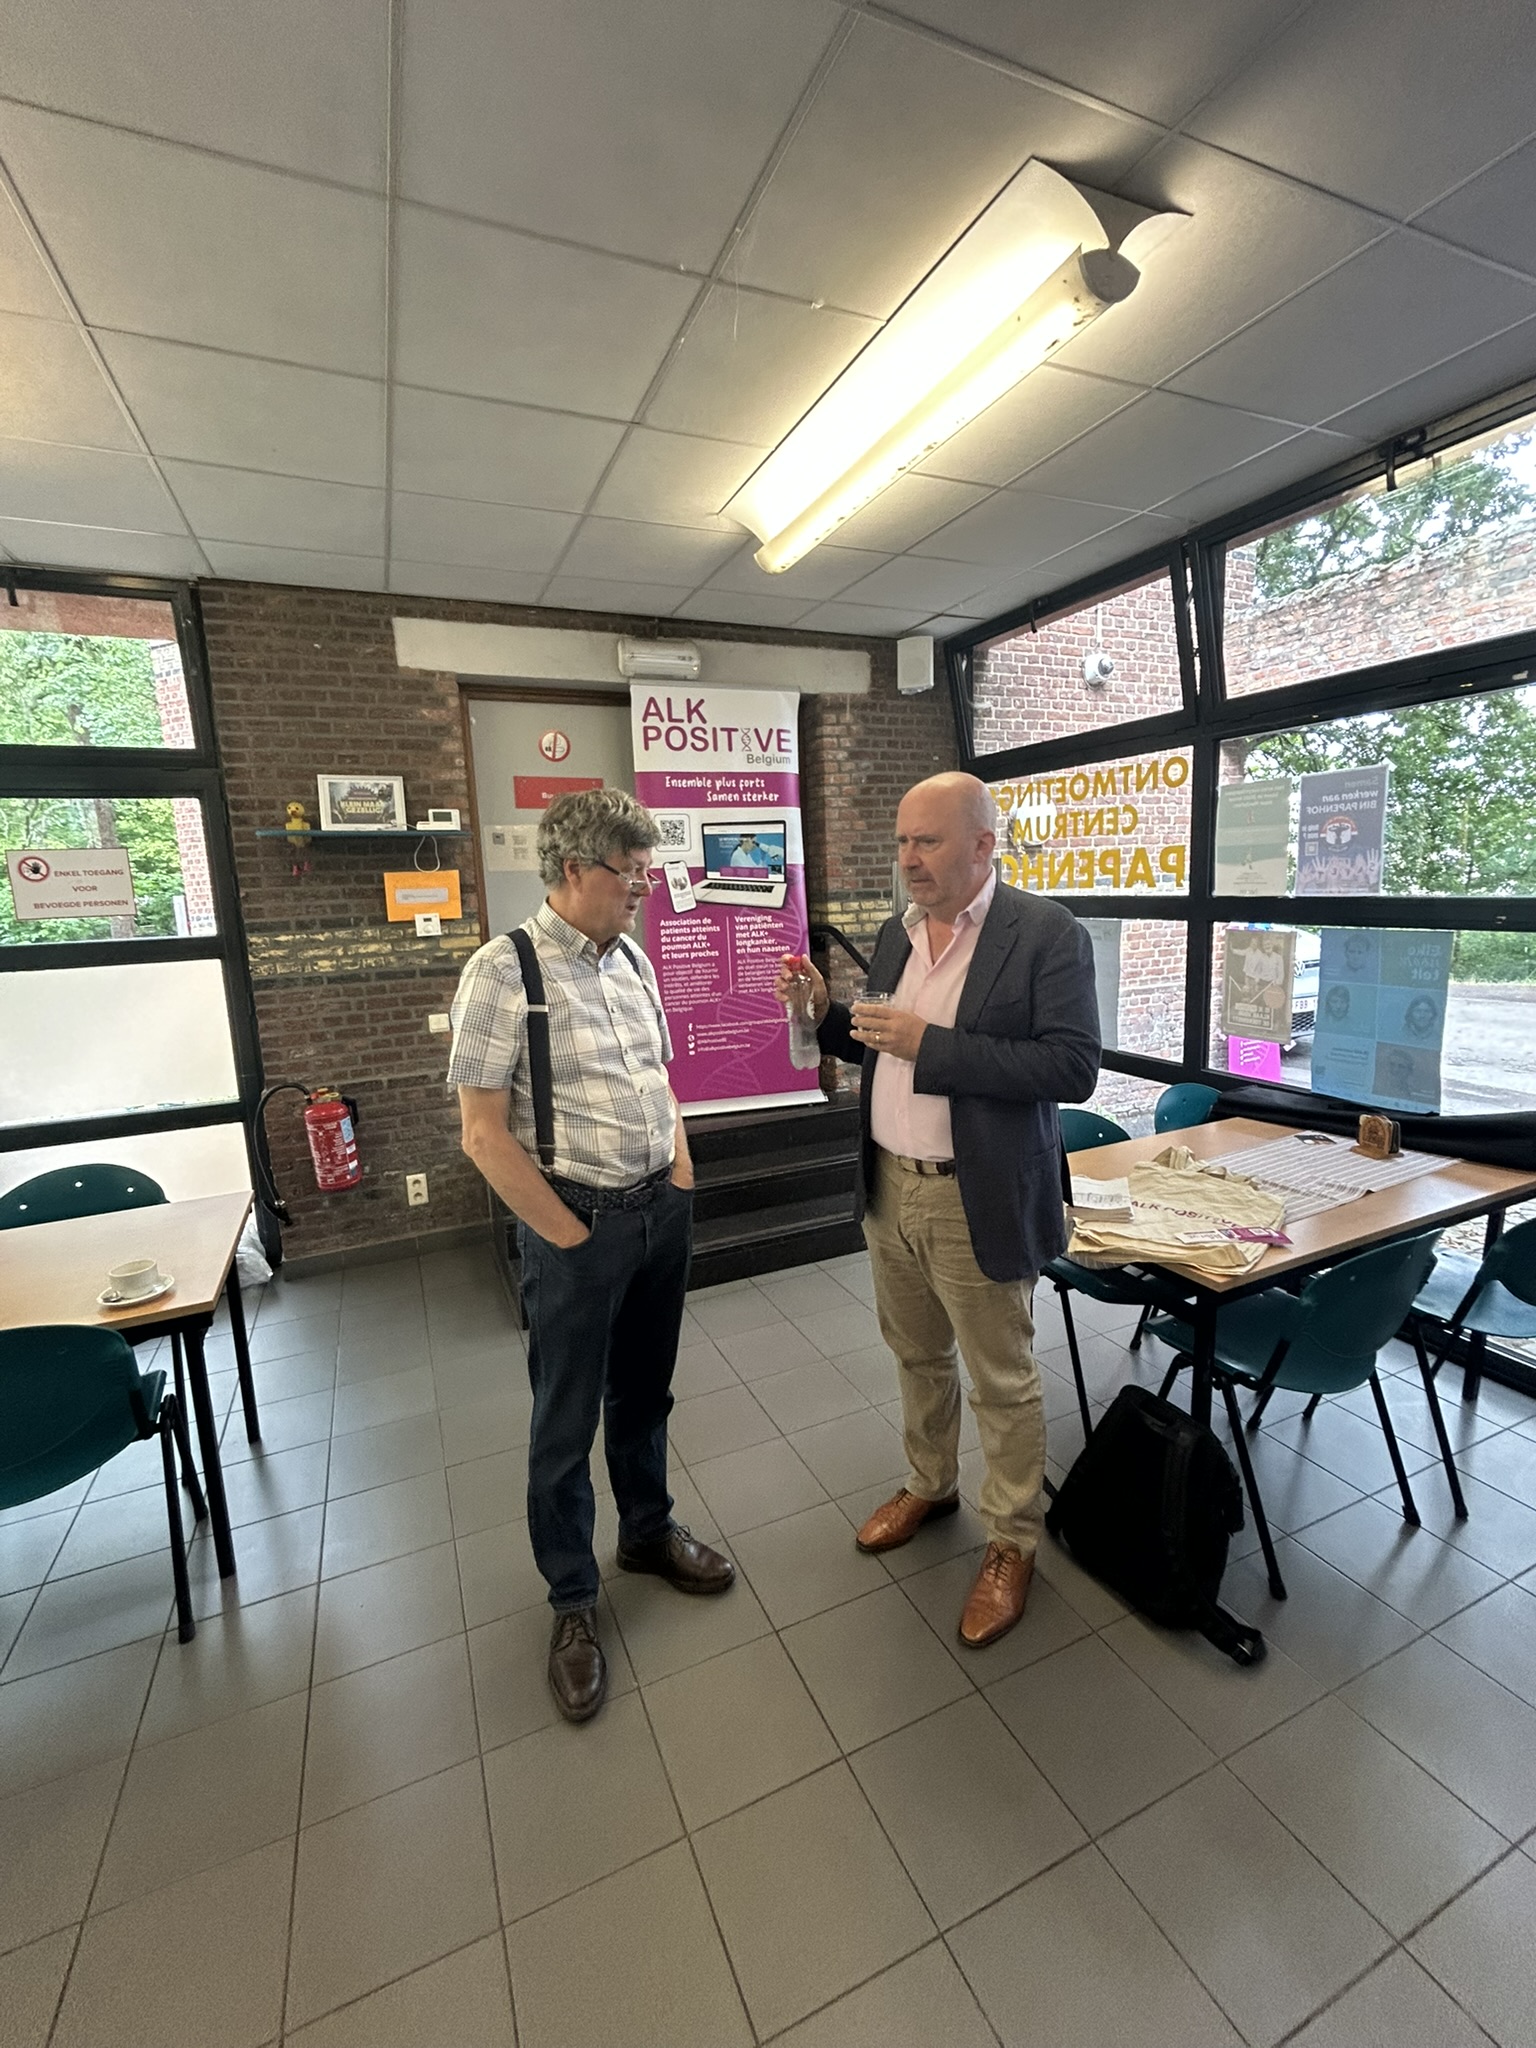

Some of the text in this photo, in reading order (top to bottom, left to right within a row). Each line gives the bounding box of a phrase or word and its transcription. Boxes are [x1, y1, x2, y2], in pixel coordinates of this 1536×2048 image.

[642, 696, 707, 724] ALK
[746, 754, 791, 766] Belgium
[665, 776, 765, 790] Ensemble plus forts
[707, 791, 779, 802] Samen sterker
[660, 919, 701, 927] Association
[734, 915, 772, 923] Vereniging
[661, 925, 720, 936] patients atteints
[749, 922, 784, 931] patiënten
[751, 930, 769, 938] ALK+
[661, 944, 691, 953] poumon
[762, 945, 790, 953] naasten
[661, 950, 719, 960] et leurs proches
[1131, 1201, 1160, 1211] ALK
